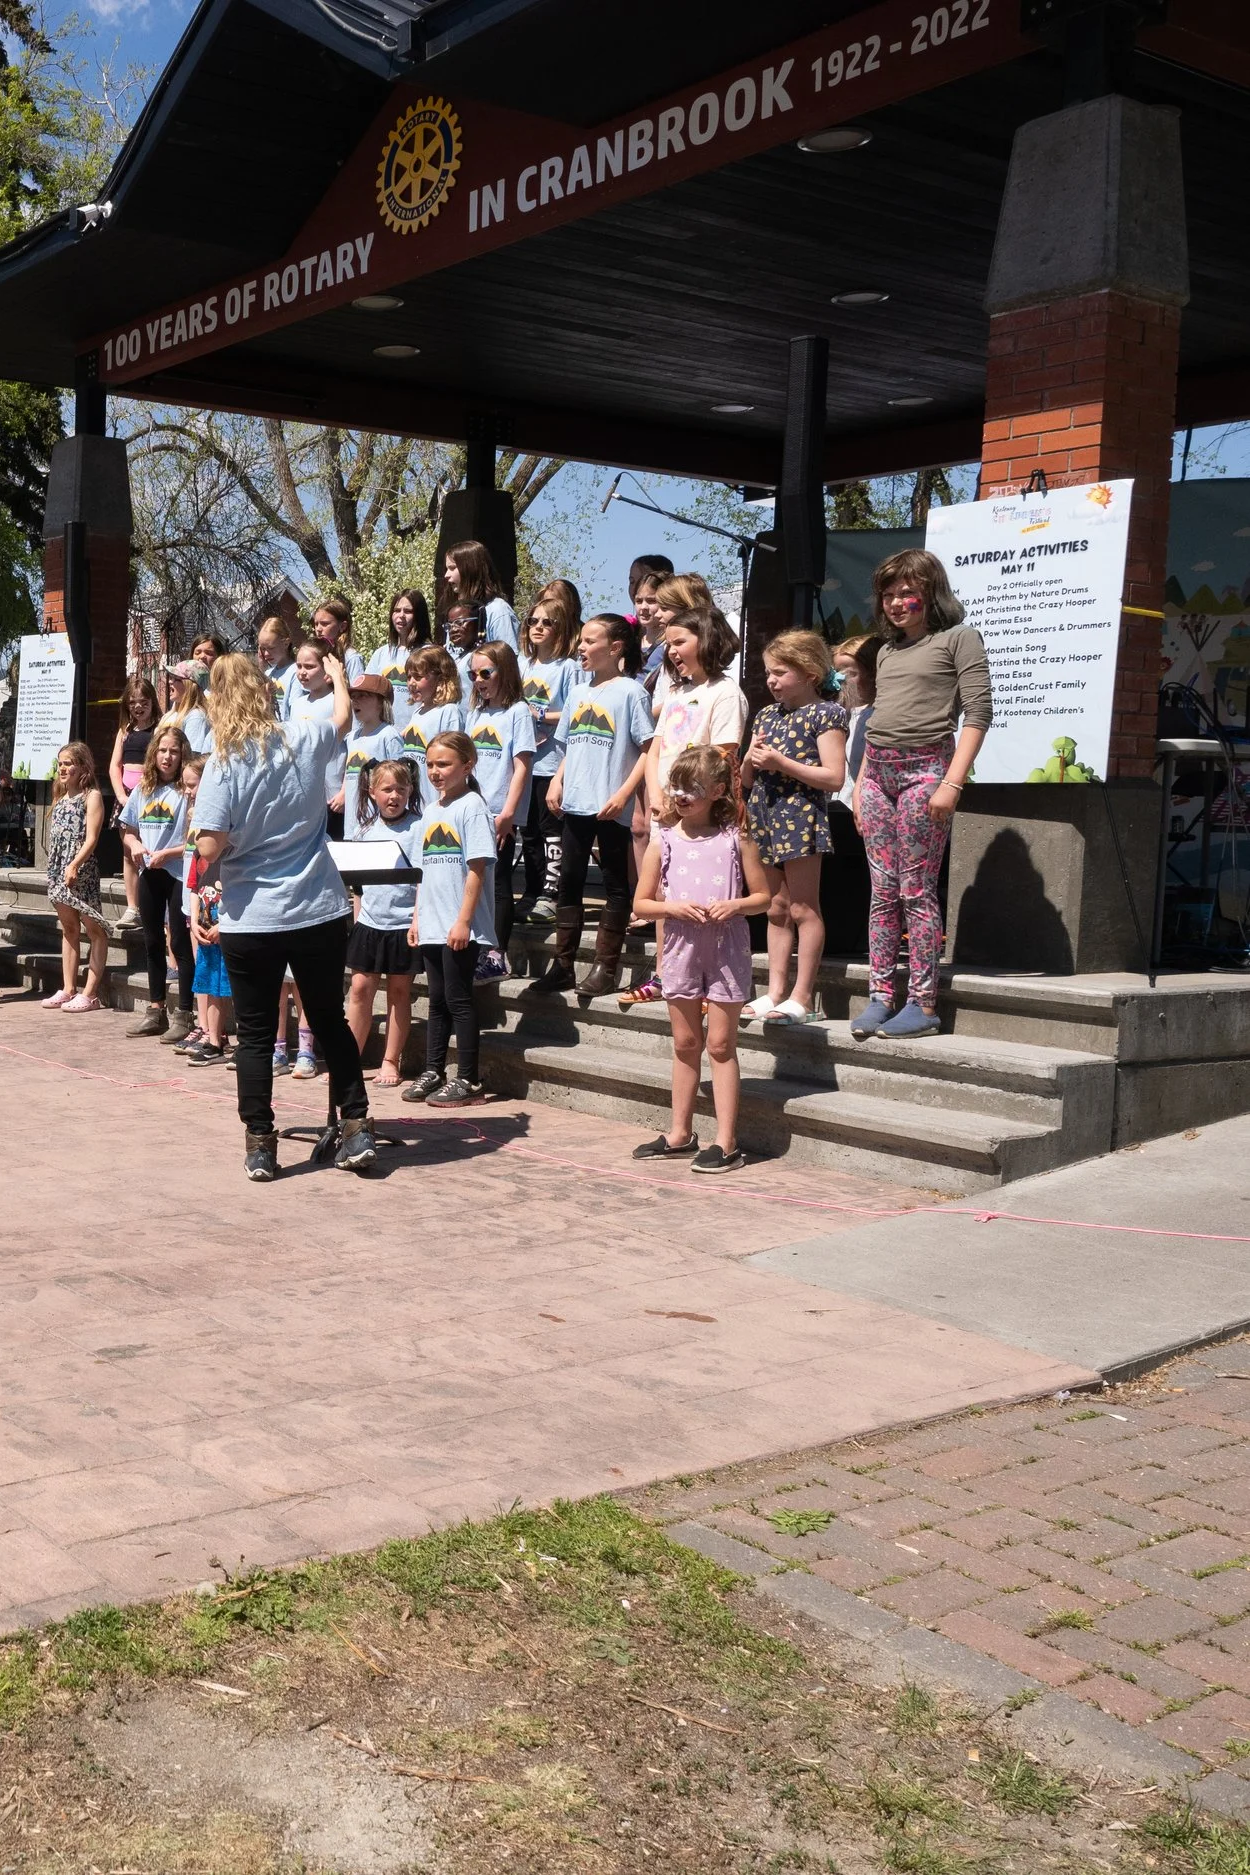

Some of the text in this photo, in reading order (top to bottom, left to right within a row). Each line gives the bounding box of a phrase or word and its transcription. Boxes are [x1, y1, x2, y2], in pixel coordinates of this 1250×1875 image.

[401, 112, 436, 136] ROTARY
[468, 177, 506, 233] IN
[516, 58, 795, 214] CRANBROOK
[811, 34, 881, 93] 1922
[910, 0, 990, 55] 2022
[388, 175, 448, 219] INTERNATIONAL
[104, 232, 374, 371] 100 YEARS OF ROTARY
[954, 539, 1089, 567] SATURDAY ACTIVITIES
[1001, 562, 1036, 576] MAY 11
[987, 584, 1001, 593] Day
[1009, 578, 1043, 590] Officially
[1044, 578, 1063, 588] open
[971, 598, 985, 606] AM
[986, 593, 1017, 604] Rhythm
[1018, 592, 1029, 601] by
[1030, 589, 1060, 598] Nature
[1061, 586, 1089, 596] Drums
[970, 609, 983, 617] AM
[985, 604, 1021, 615] Christina
[1023, 603, 1037, 611] the
[1038, 600, 1063, 610] Crazy
[1065, 598, 1097, 608] Hooper
[984, 617, 1012, 626] Karima
[1014, 615, 1033, 624] Essa
[983, 620, 1112, 638] Pow Wow Dancers & Drummers
[1025, 644, 1047, 653] Song
[988, 653, 1103, 668] hristina the Crazy Hooper
[990, 670, 1033, 680] rima Essa
[998, 681, 1053, 692] GoldenCrust
[1055, 679, 1087, 690] Family
[1015, 695, 1045, 704] Finale!
[1003, 708, 1042, 717] Kootenay
[1043, 706, 1085, 715] Children's
[590, 736, 614, 750] Song
